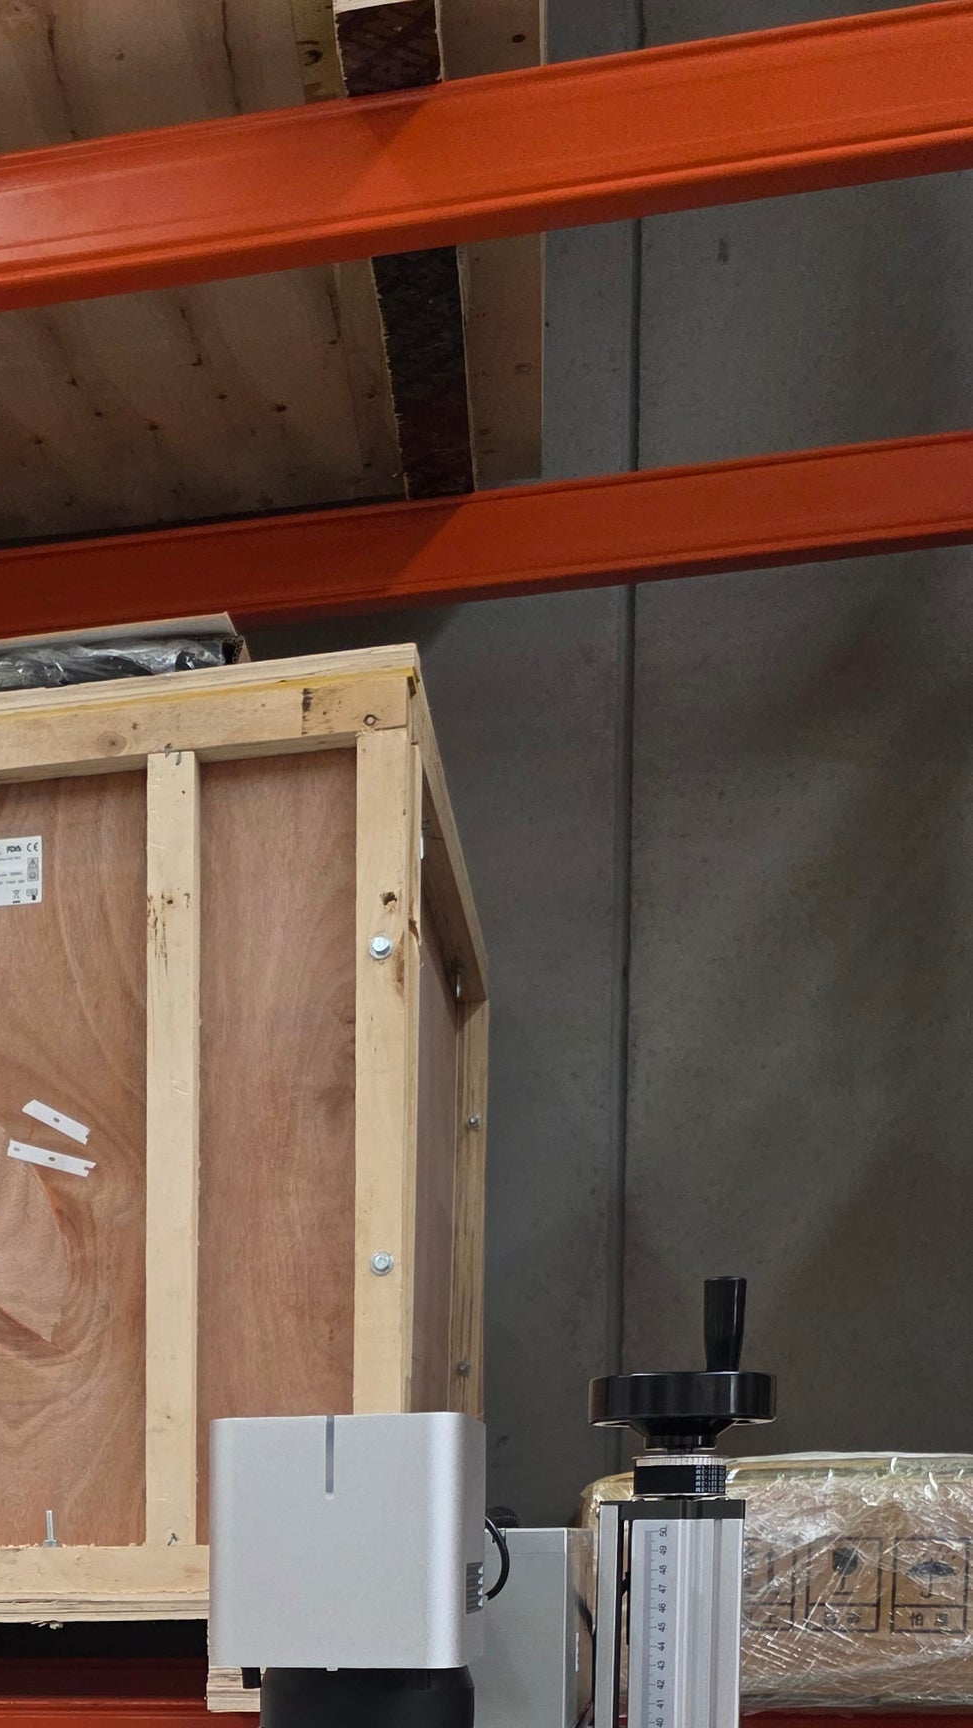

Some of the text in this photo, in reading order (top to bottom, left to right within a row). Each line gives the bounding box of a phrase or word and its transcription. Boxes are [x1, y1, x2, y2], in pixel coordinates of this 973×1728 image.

[659, 1584, 666, 1593] 47
[657, 1661, 665, 1670] 43
[657, 1680, 664, 1689] 42
[657, 1700, 664, 1708] 41
[656, 1718, 664, 1728] 40
